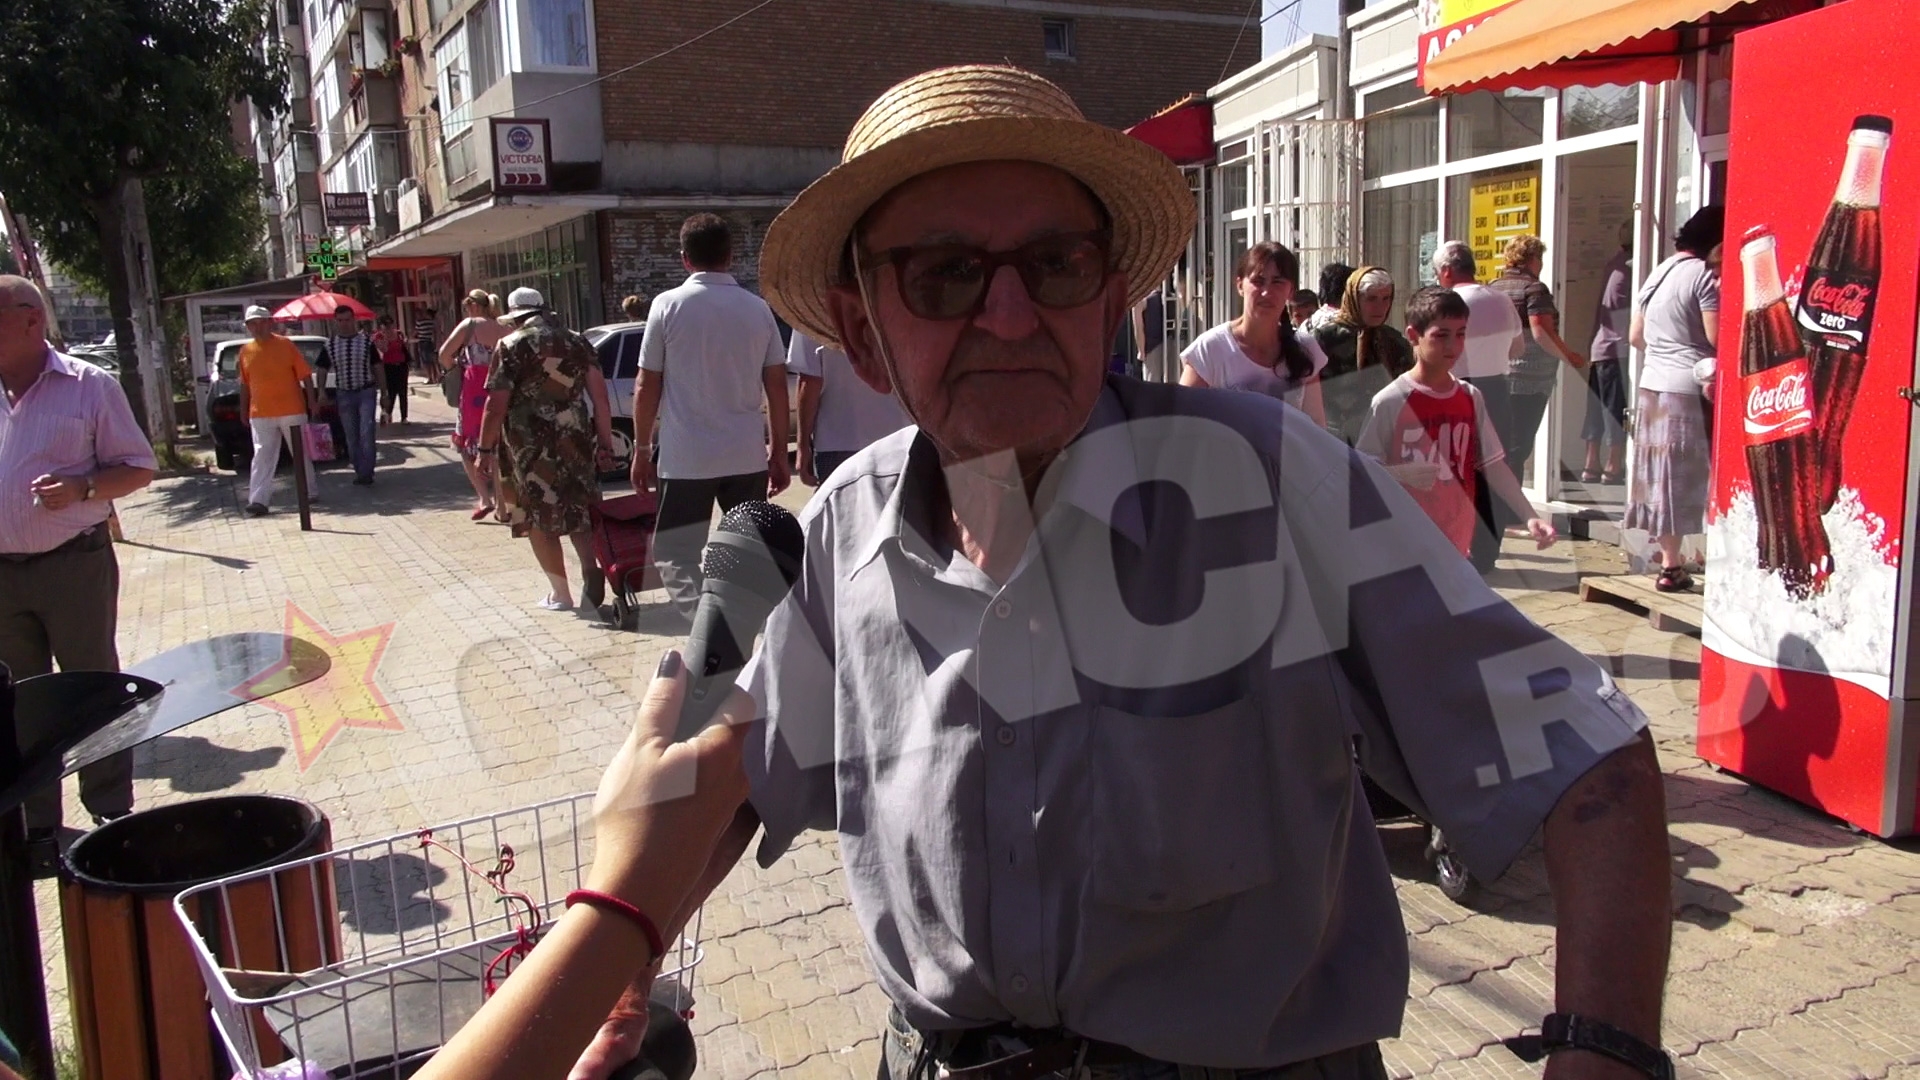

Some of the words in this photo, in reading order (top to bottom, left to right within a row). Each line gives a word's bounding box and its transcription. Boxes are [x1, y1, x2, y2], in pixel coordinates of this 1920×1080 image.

[500, 154, 544, 164] VICTORIA
[336, 196, 366, 206] CABINET
[1475, 216, 1488, 228] EURO
[1807, 277, 1872, 318] Coca-Cola
[1820, 312, 1846, 330] zero
[1747, 372, 1808, 419] Coca-Cola
